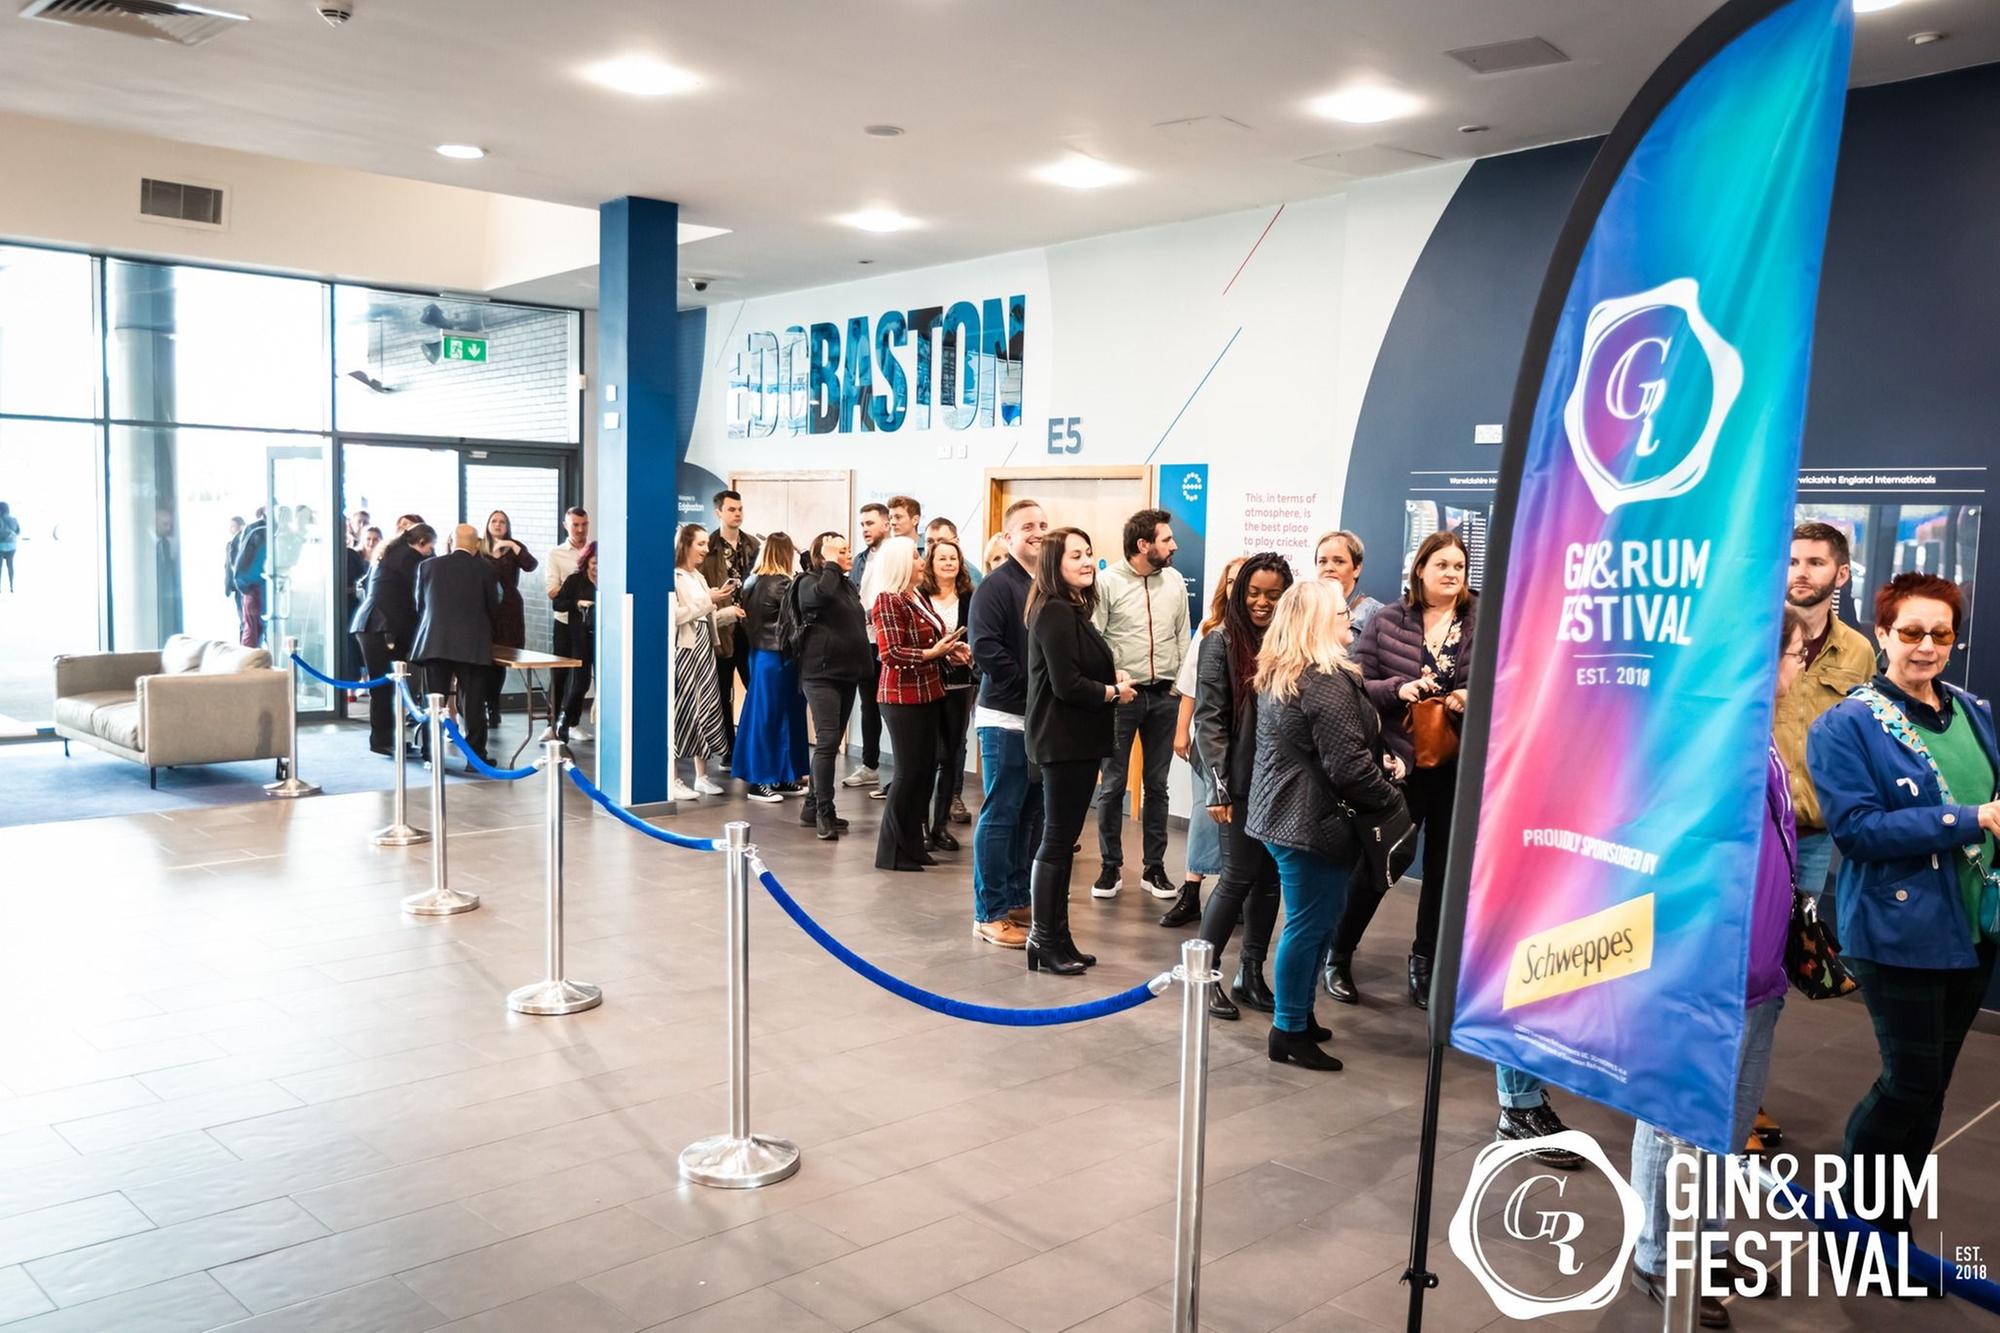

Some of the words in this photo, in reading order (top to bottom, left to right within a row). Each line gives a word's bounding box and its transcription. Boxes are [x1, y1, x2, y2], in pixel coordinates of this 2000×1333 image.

[727, 294, 1026, 439] EDGBASTON
[1047, 417, 1082, 455] E5
[1798, 475, 1837, 485] wickshire
[1838, 475, 1873, 486] England
[1874, 475, 1936, 485] Internationals
[1245, 493, 1265, 504] This,
[1267, 493, 1276, 503] in
[1277, 494, 1304, 504] terms
[1306, 493, 1317, 504] of
[1303, 508, 1311, 518] is
[1244, 522, 1259, 532] the
[1260, 522, 1281, 533] best
[1283, 523, 1309, 536] place
[1243, 536, 1254, 546] to
[1255, 536, 1275, 550] play
[1276, 537, 1310, 548] cricket.
[1576, 667, 1611, 686] EST.
[1616, 667, 1650, 687] 2018
[1522, 828, 1583, 853] PROUDLY
[1580, 835, 1644, 871] SPONSORED
[1640, 851, 1659, 875] BY
[1522, 928, 1633, 984] Schweppes
